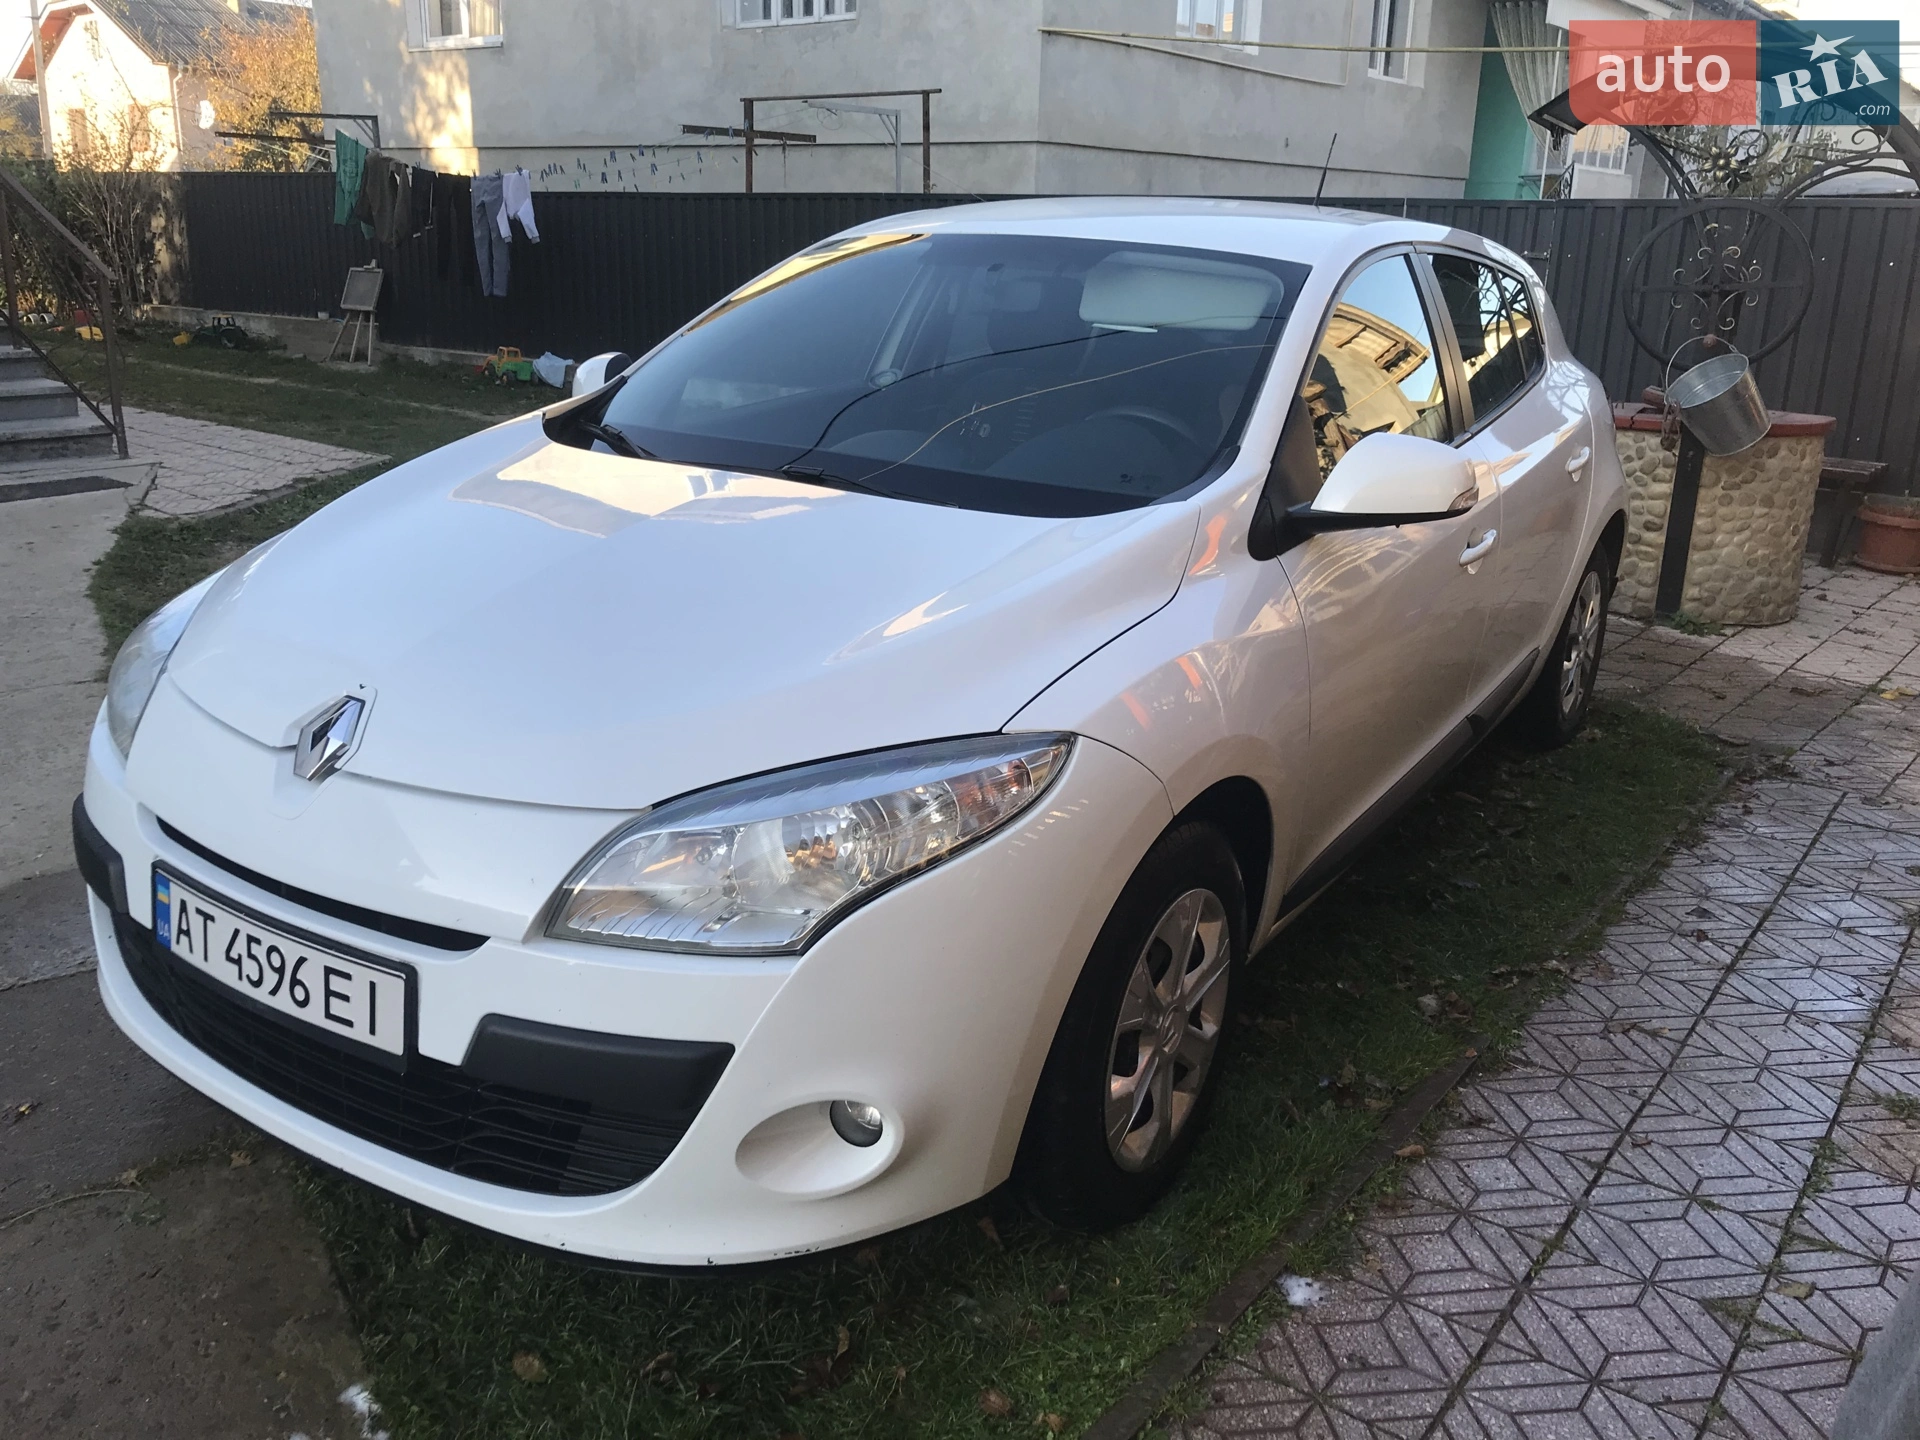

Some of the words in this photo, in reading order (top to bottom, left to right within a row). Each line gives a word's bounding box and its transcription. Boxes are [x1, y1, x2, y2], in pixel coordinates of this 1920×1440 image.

[157, 918, 170, 941] UA
[176, 898, 216, 962] AT
[224, 928, 311, 1009] 4596
[323, 964, 377, 1036] EI
